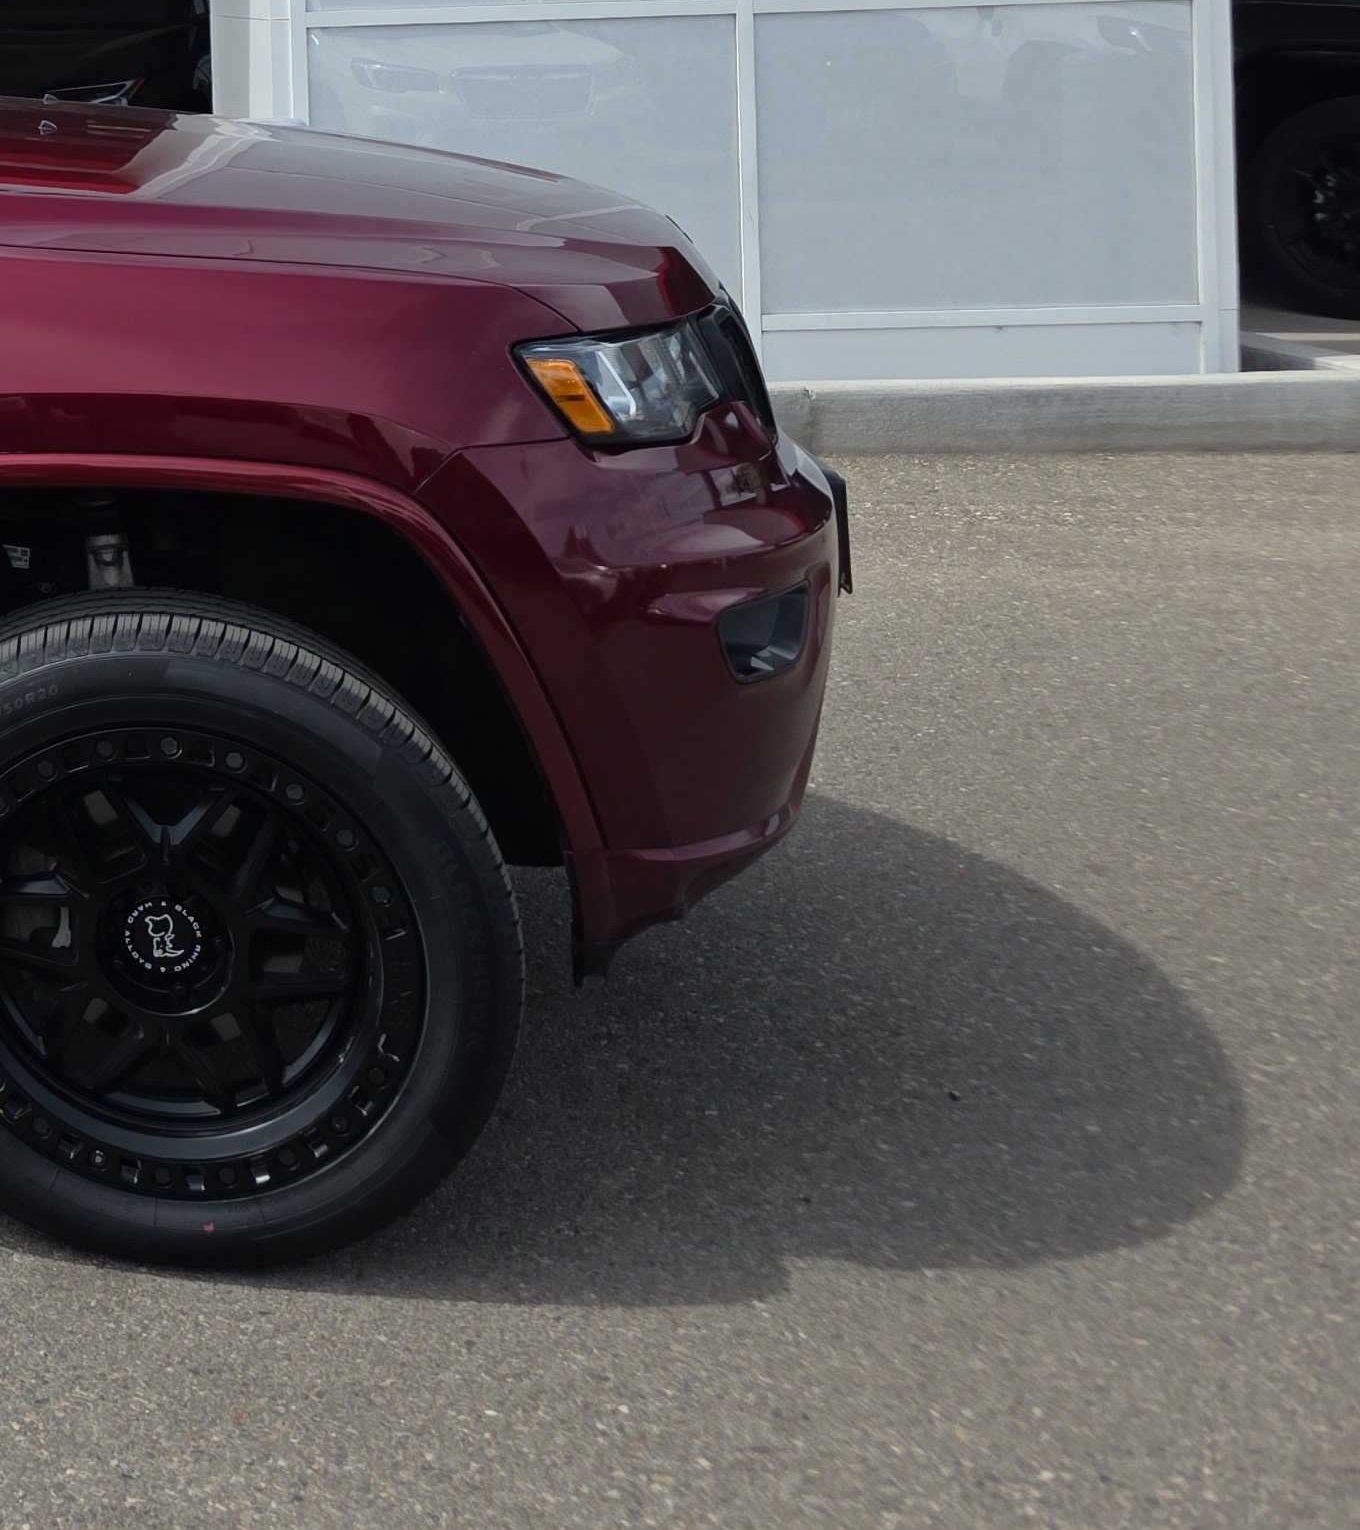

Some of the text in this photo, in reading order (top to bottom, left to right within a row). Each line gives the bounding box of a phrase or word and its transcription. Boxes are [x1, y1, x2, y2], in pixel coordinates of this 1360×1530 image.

[125, 902, 153, 969] HARD ALLOYS
[173, 903, 202, 973] BLACK RHINO
